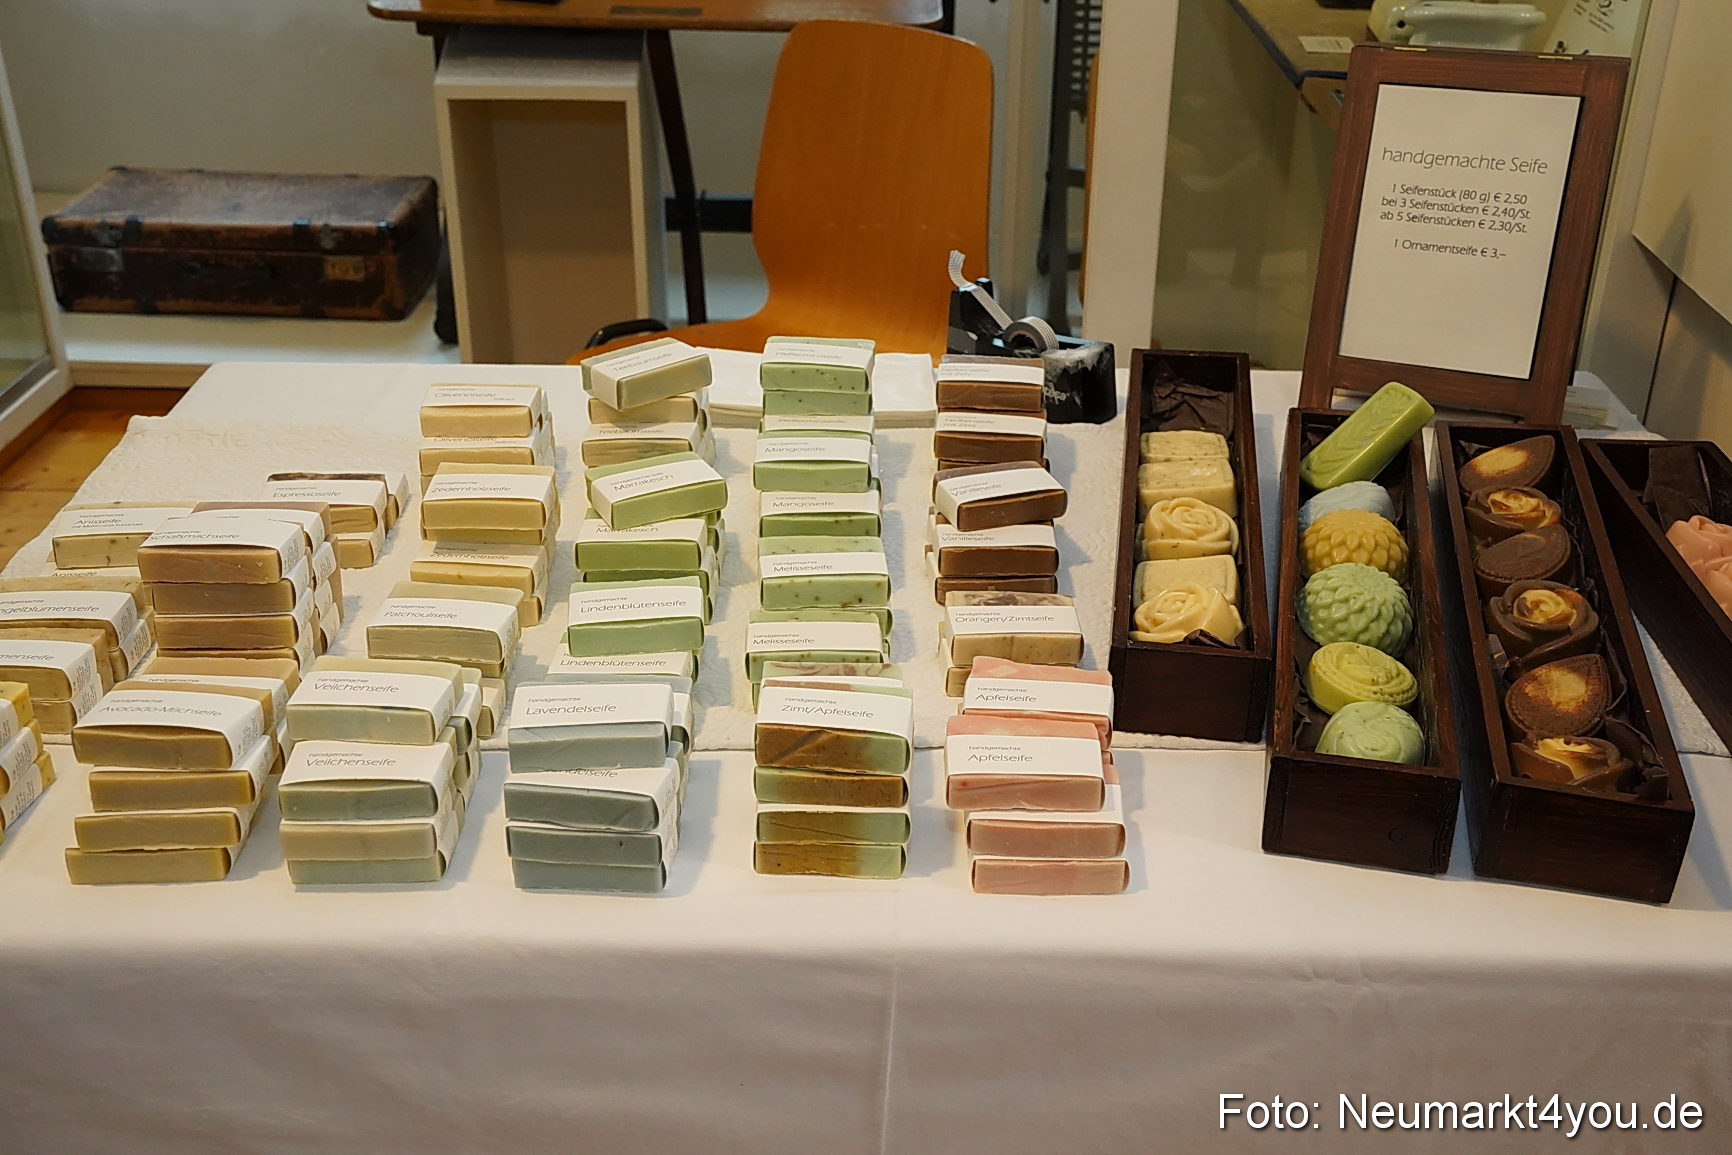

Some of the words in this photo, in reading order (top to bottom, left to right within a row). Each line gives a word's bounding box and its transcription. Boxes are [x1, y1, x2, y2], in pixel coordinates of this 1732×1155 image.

[1382, 147, 1506, 170] handgemachte
[1510, 156, 1548, 174] Seife
[1392, 183, 1397, 193] 1
[1400, 184, 1457, 199] Seifenstück
[1459, 189, 1478, 202] (80
[1479, 191, 1491, 204] g)
[1494, 192, 1502, 203] €
[1503, 193, 1528, 205] 2,50
[1381, 196, 1398, 207] bei
[1400, 199, 1407, 208] 3
[1409, 198, 1479, 215] Seifenstücken
[1482, 204, 1490, 215] €
[1492, 206, 1532, 221] 2,40/St.
[1380, 211, 1394, 221] ab
[1396, 211, 1403, 222] 5
[1405, 212, 1476, 228] Seifenstücken
[1478, 219, 1486, 230] €
[1488, 219, 1528, 234] 2,30/St.
[1394, 238, 1398, 248] 1
[1402, 239, 1478, 256] Ornamentseife
[1480, 246, 1488, 258] €
[614, 474, 674, 491] Marrakesch
[951, 484, 1002, 497] Vanilleseife
[430, 552, 510, 561] Zedernholzseife
[773, 564, 833, 573] Melisseseife
[0, 605, 100, 615] ngelblumenseife
[581, 600, 687, 614] Lindenblütenseife
[384, 611, 458, 620] Patchouliseife
[955, 615, 1055, 623] Orangen/Zimtseife
[560, 659, 667, 667] Lindenblütenseife
[314, 683, 399, 693] Veilchenseife
[975, 693, 1037, 702] Apfelseife
[99, 706, 223, 718] Avocado-Milchseife
[526, 704, 617, 715] Lavendelseife
[782, 704, 874, 719] Zimt/Apfelseife
[306, 758, 396, 767] Veilchenseife
[968, 754, 1033, 763] Apfelseife
